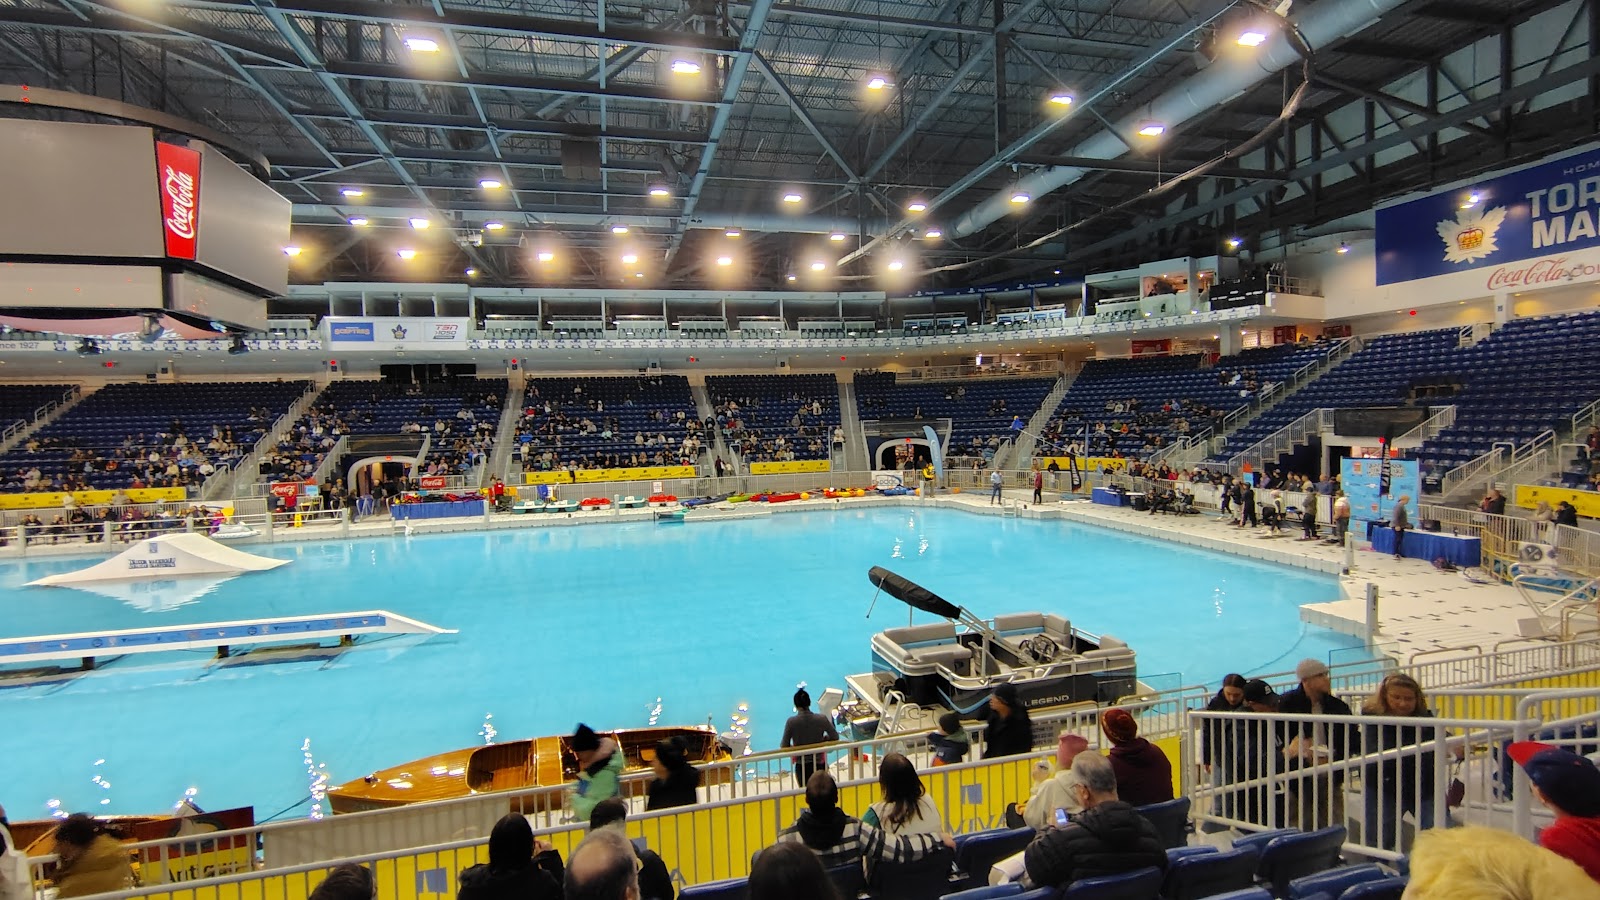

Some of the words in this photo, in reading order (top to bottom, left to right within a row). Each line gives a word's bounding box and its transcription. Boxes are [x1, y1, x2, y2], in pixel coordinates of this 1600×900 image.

[166, 164, 195, 240] Coca-Cola
[1526, 175, 1600, 218] TOR
[1532, 207, 1600, 249] MA
[1486, 257, 1568, 291] Coca-Cola
[19, 341, 39, 350] 1927
[1024, 694, 1070, 708] LEGEND
